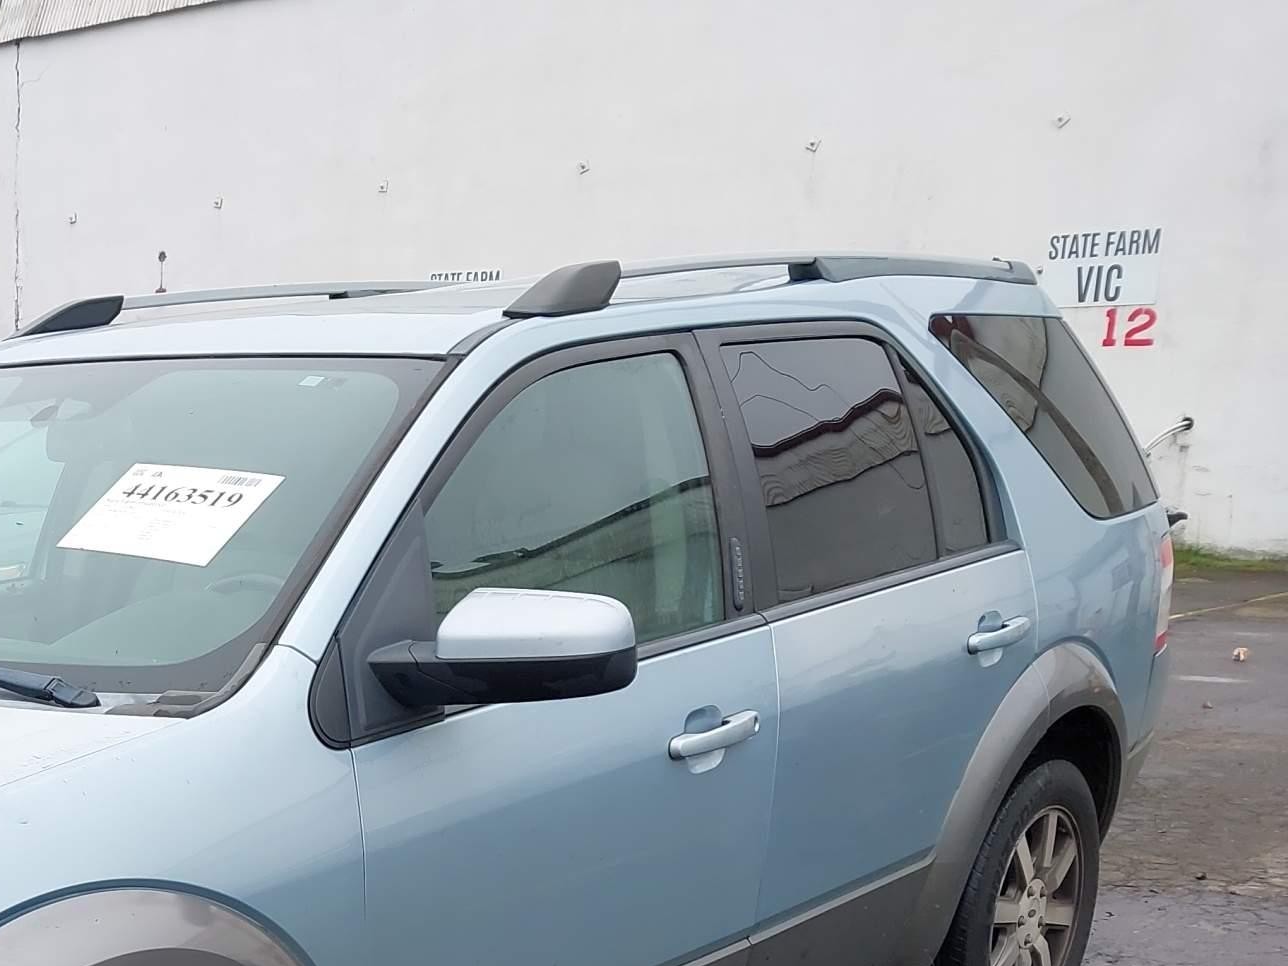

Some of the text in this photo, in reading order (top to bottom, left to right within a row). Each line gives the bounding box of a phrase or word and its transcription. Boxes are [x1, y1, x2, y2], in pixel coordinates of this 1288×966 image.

[1048, 228, 1161, 260] STATE FARM
[1077, 263, 1123, 303] VIC
[1102, 307, 1157, 347] 12
[122, 483, 244, 508] 44163519
